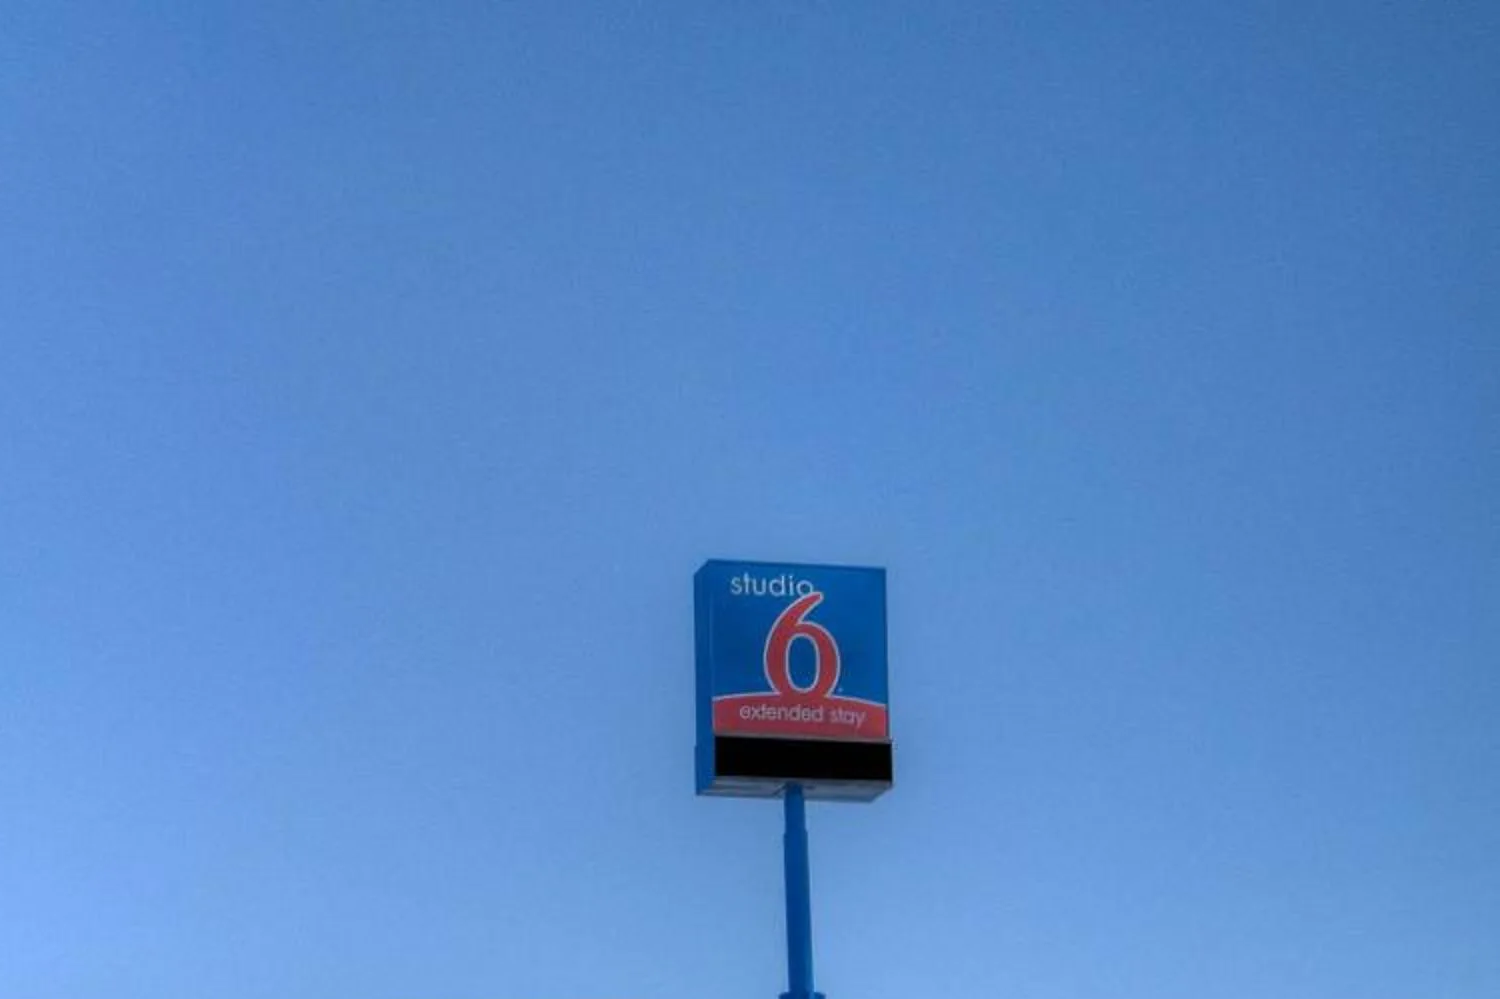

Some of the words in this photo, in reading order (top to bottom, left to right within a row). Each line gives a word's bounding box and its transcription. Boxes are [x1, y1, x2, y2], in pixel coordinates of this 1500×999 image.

[730, 572, 814, 597] studio
[763, 592, 842, 697] 6
[739, 704, 824, 723] extended
[830, 705, 866, 728] stay
